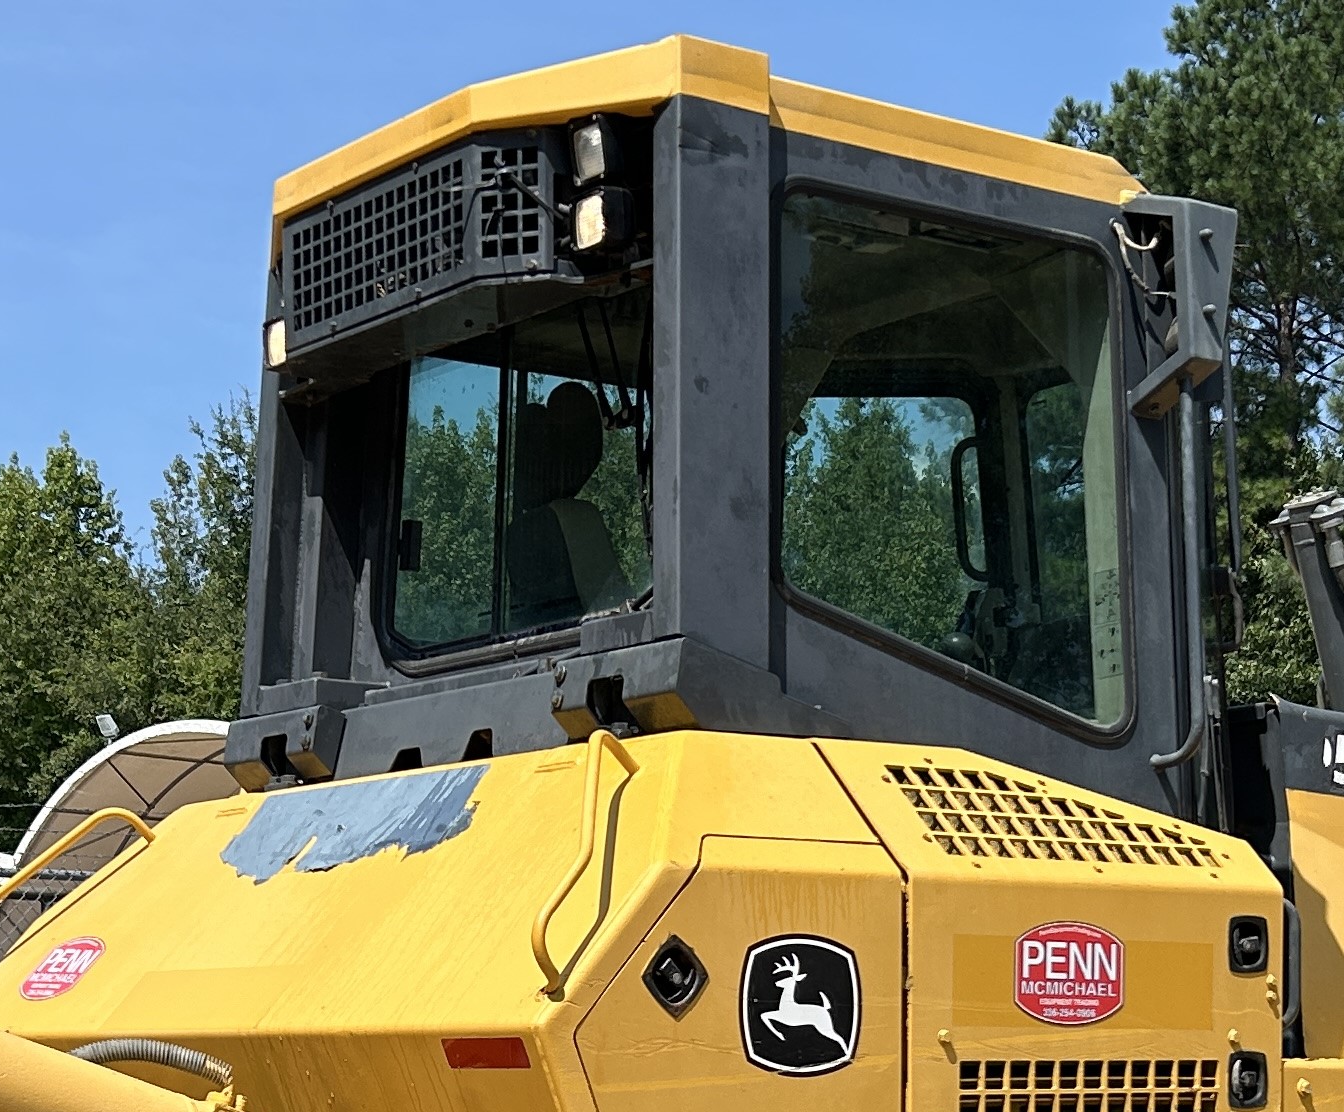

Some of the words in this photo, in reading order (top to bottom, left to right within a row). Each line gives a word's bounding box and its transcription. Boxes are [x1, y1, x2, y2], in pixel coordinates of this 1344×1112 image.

[36, 948, 102, 974] PENN
[1022, 941, 1117, 980] PENN
[1021, 980, 1116, 996] MCMICHAEL
